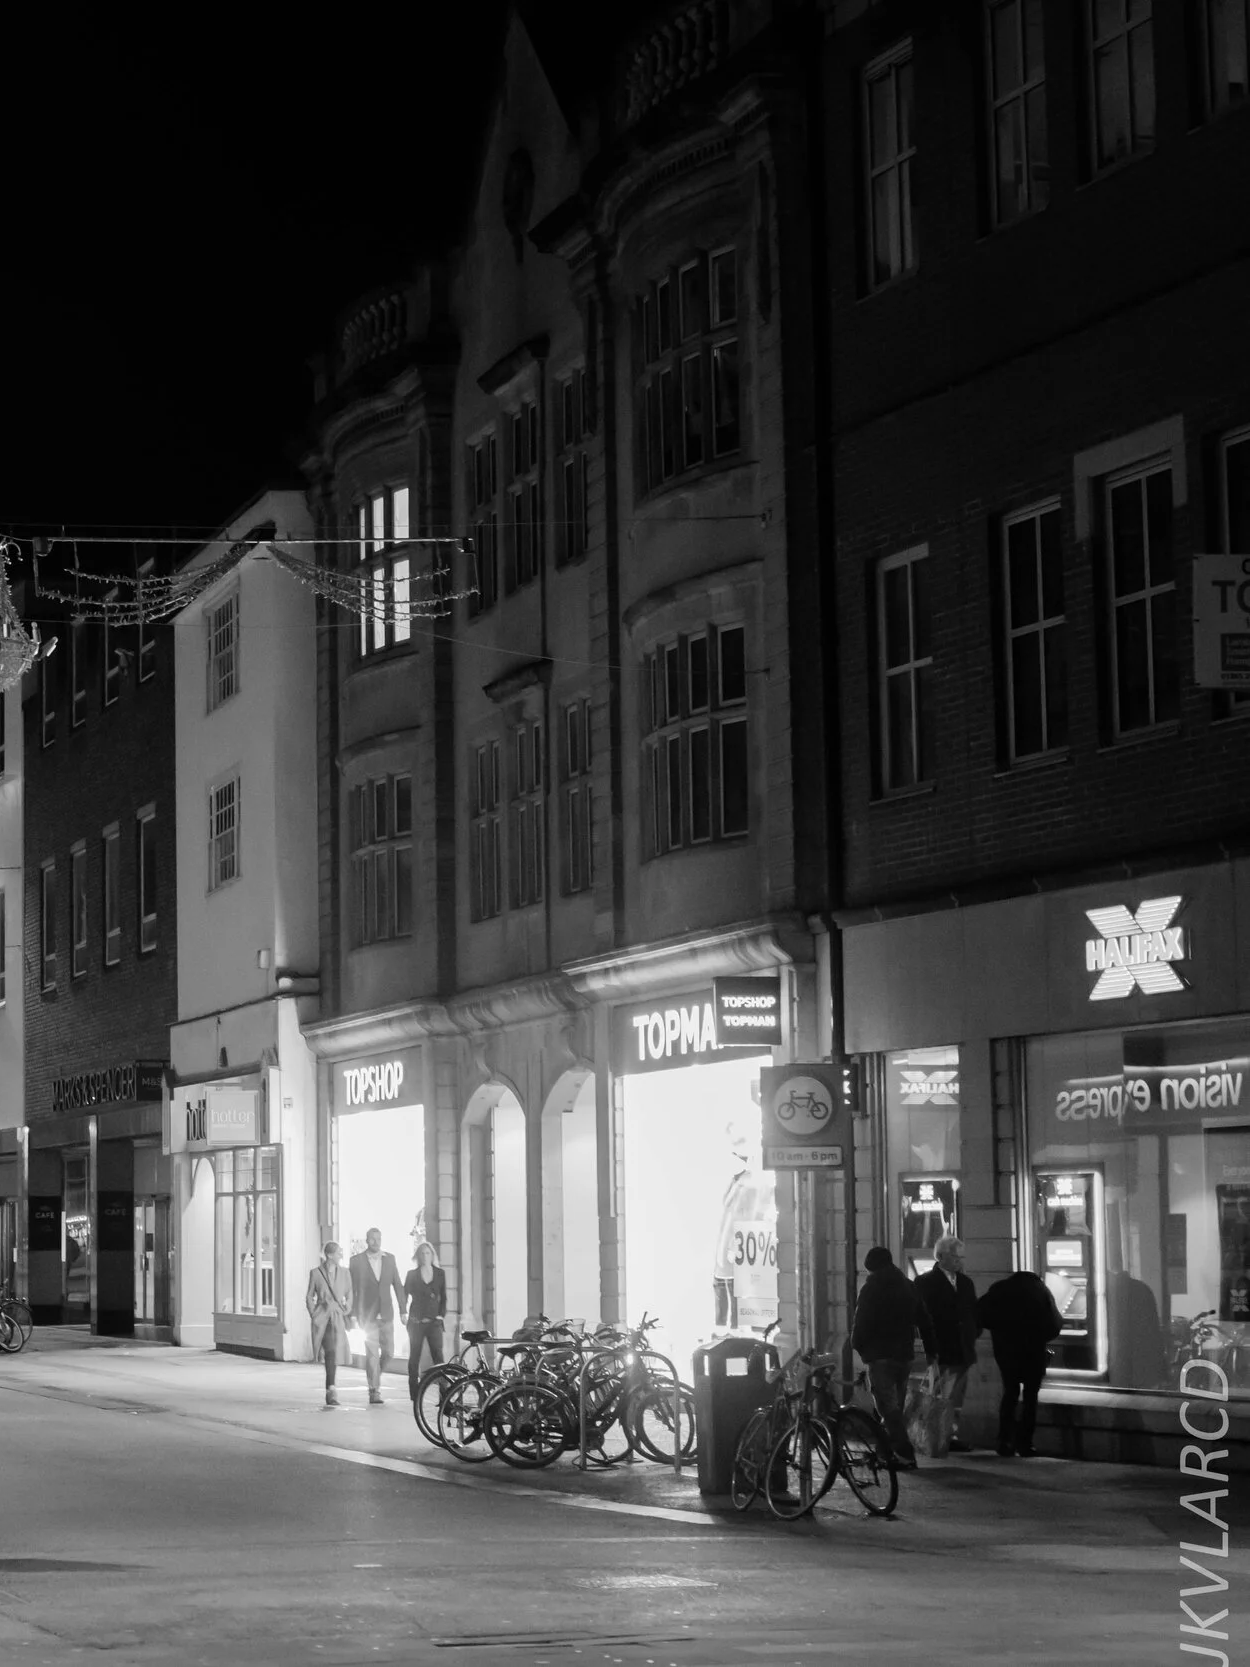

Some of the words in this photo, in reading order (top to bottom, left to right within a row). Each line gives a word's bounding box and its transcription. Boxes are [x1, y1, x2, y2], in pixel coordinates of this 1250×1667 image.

[1085, 927, 1184, 972] HALIFAX
[721, 996, 776, 1008] TOPSHOP
[633, 1003, 718, 1061] TOPMA
[722, 1015, 776, 1027] TOPMAN
[343, 1060, 404, 1106] TOPSHOP
[210, 1108, 255, 1124] hotter
[811, 1151, 819, 1161] 6
[820, 1152, 838, 1163] pm
[734, 1230, 777, 1267] 30%
